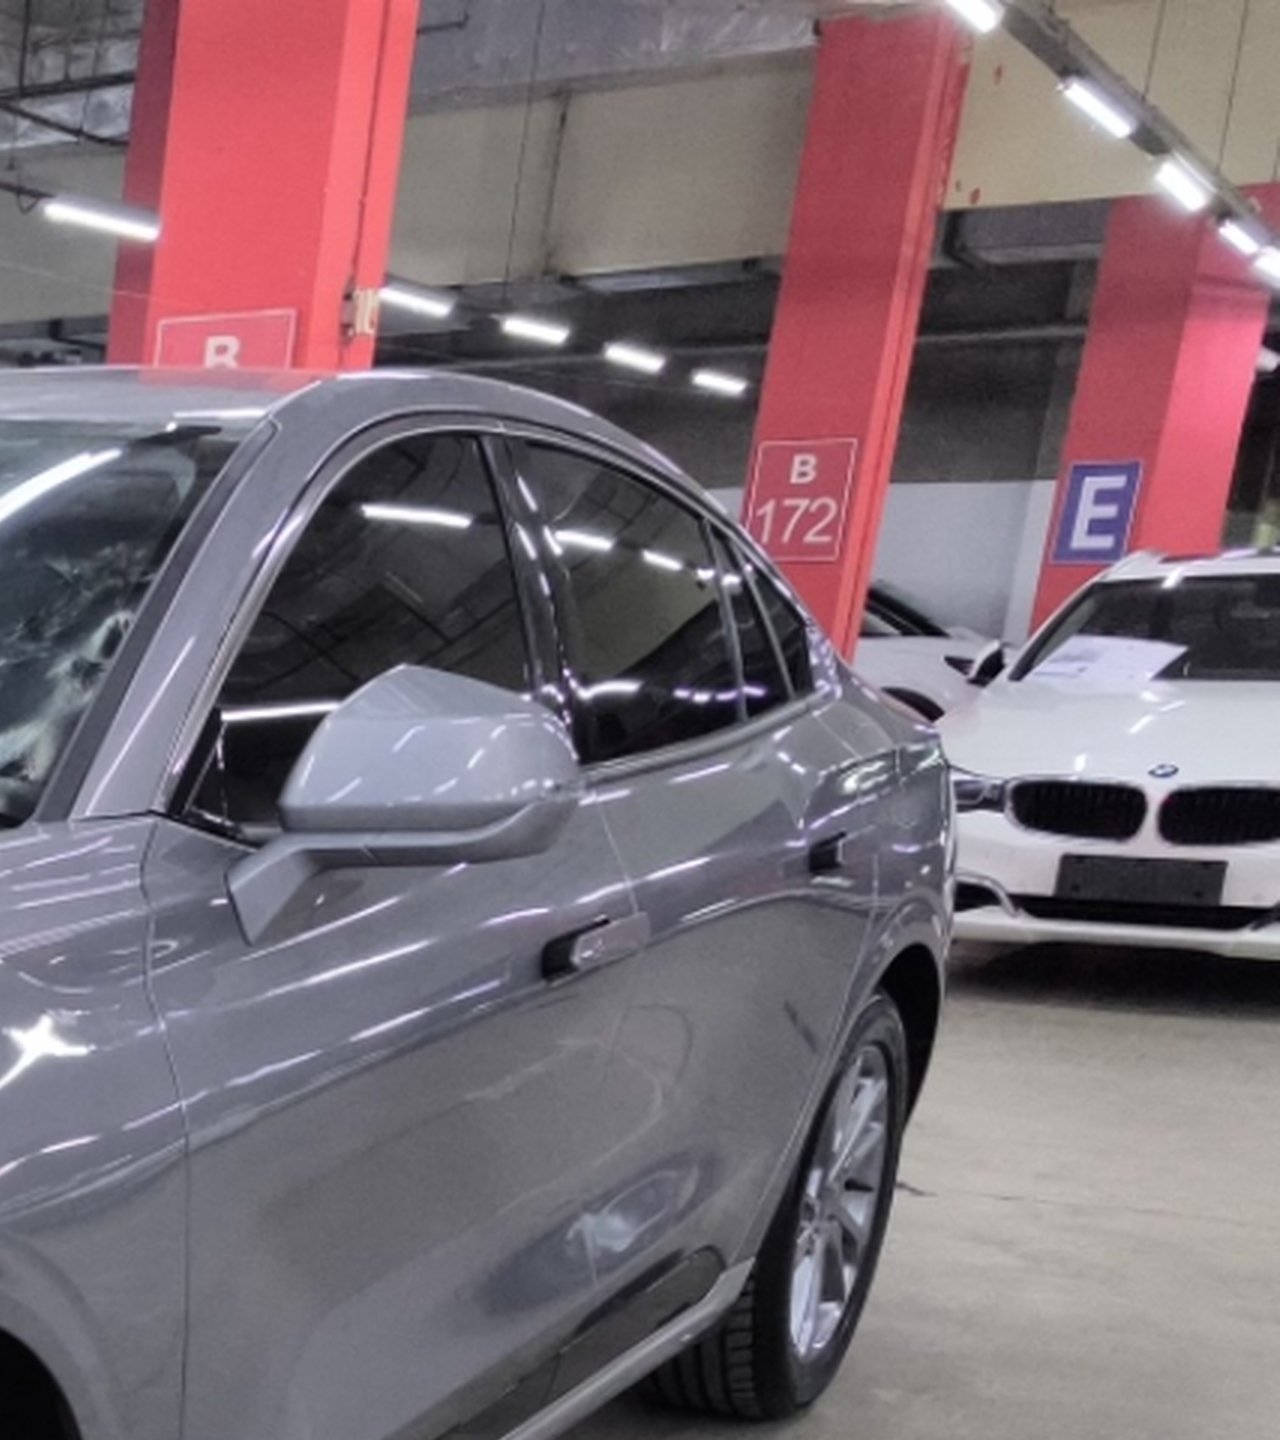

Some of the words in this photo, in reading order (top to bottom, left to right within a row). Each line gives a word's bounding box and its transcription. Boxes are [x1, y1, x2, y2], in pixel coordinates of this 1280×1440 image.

[790, 454, 817, 484] B
[756, 497, 838, 543] 172
[1070, 474, 1128, 549] E
